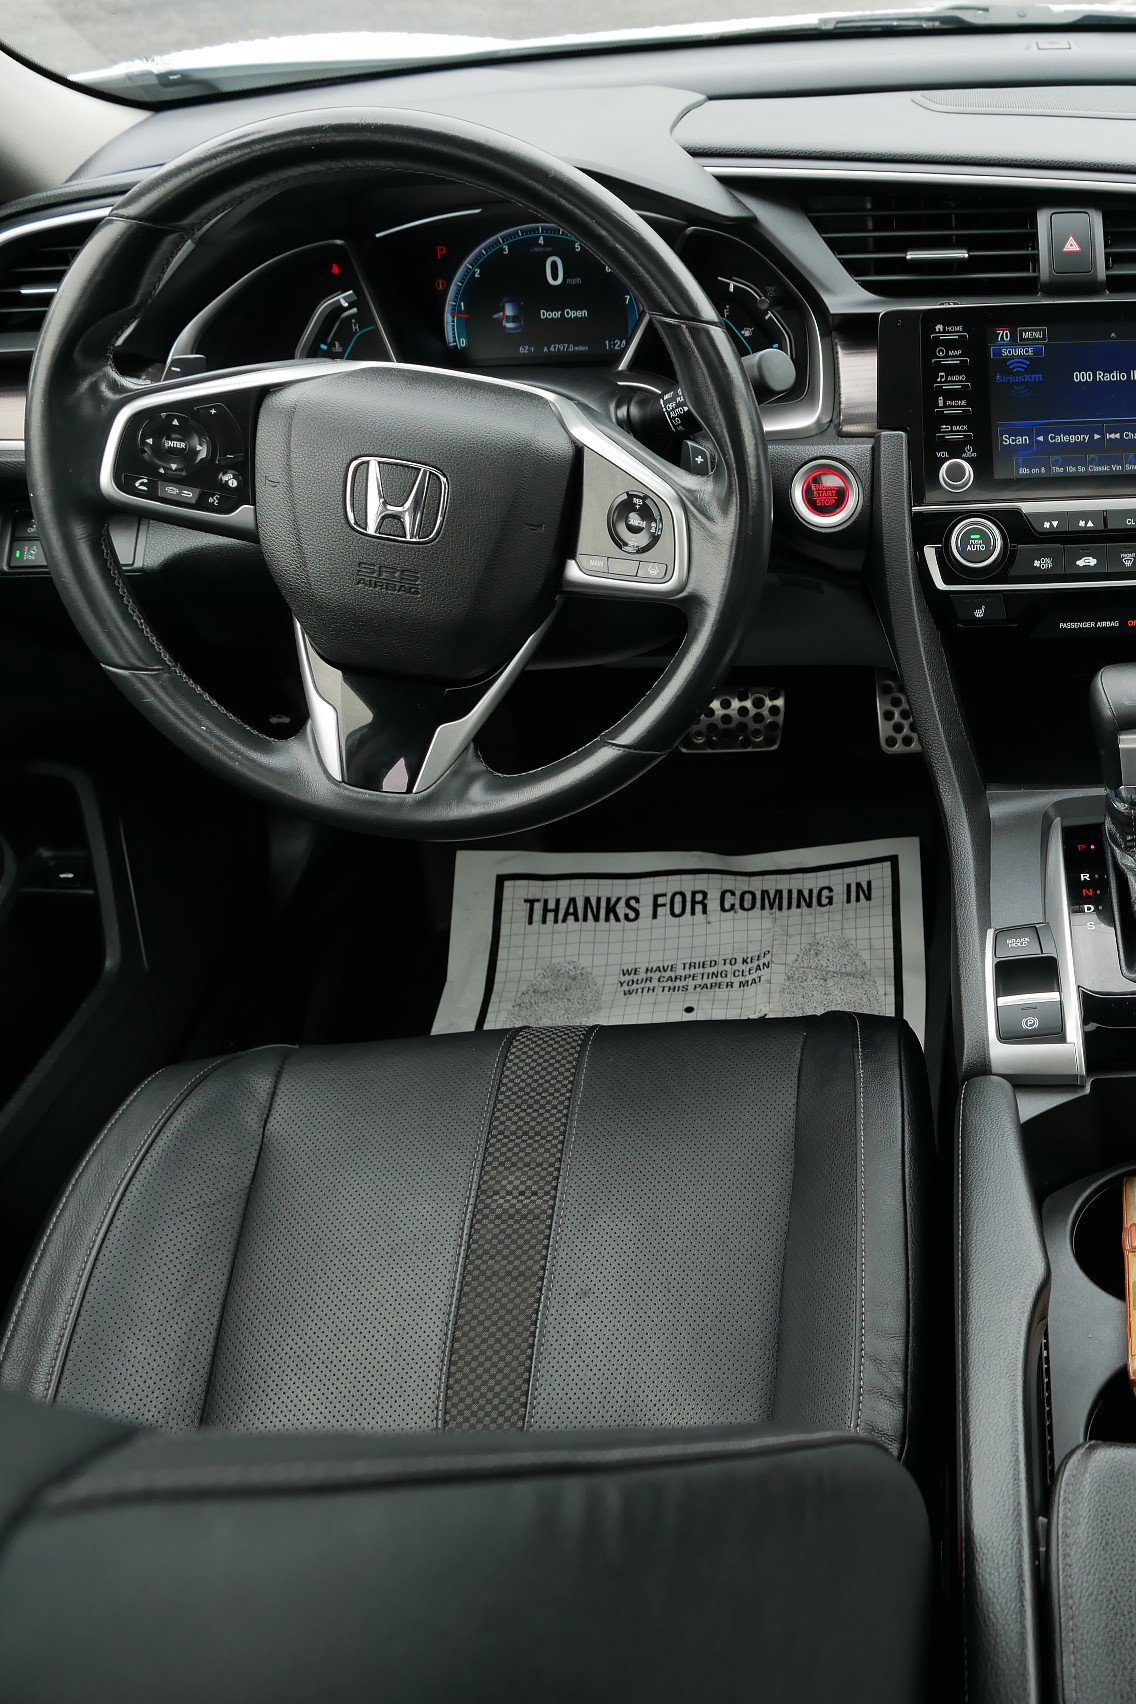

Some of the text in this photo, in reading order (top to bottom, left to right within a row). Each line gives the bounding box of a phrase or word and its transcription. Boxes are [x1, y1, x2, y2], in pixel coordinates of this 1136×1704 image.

[538, 236, 544, 245] 4
[503, 245, 509, 254] 3
[575, 242, 581, 252] 5
[437, 246, 447, 259] P
[474, 269, 480, 277] 2
[545, 255, 582, 286] 0 mph
[625, 295, 630, 304] 7
[540, 309, 588, 319] Door Open
[997, 330, 1010, 341] 70
[1022, 331, 1043, 339] MENU
[460, 338, 466, 347] 0
[1002, 348, 1034, 356] SOURCE
[1073, 371, 1093, 382] 000
[1096, 370, 1127, 381] Radio
[670, 407, 684, 418] AUTO
[1002, 434, 1029, 444] Scan
[1048, 433, 1089, 443] Category
[164, 440, 186, 449] ENTER
[1077, 465, 1086, 473] Sp
[1088, 464, 1110, 472] Classic
[813, 490, 837, 498] START
[590, 560, 604, 568] MAIN
[1059, 621, 1095, 629] PASSENGER
[1096, 620, 1119, 628] AIRBAG
[524, 880, 873, 926] THANKS FOR COMING IN
[1084, 905, 1095, 913] D
[1086, 922, 1096, 930] S
[621, 950, 771, 977] WE HAVE TRIED TO KEEP
[618, 961, 770, 988] YOUR CARPETING CLEAN
[623, 975, 764, 996] WITH THIS PAPER MAT
